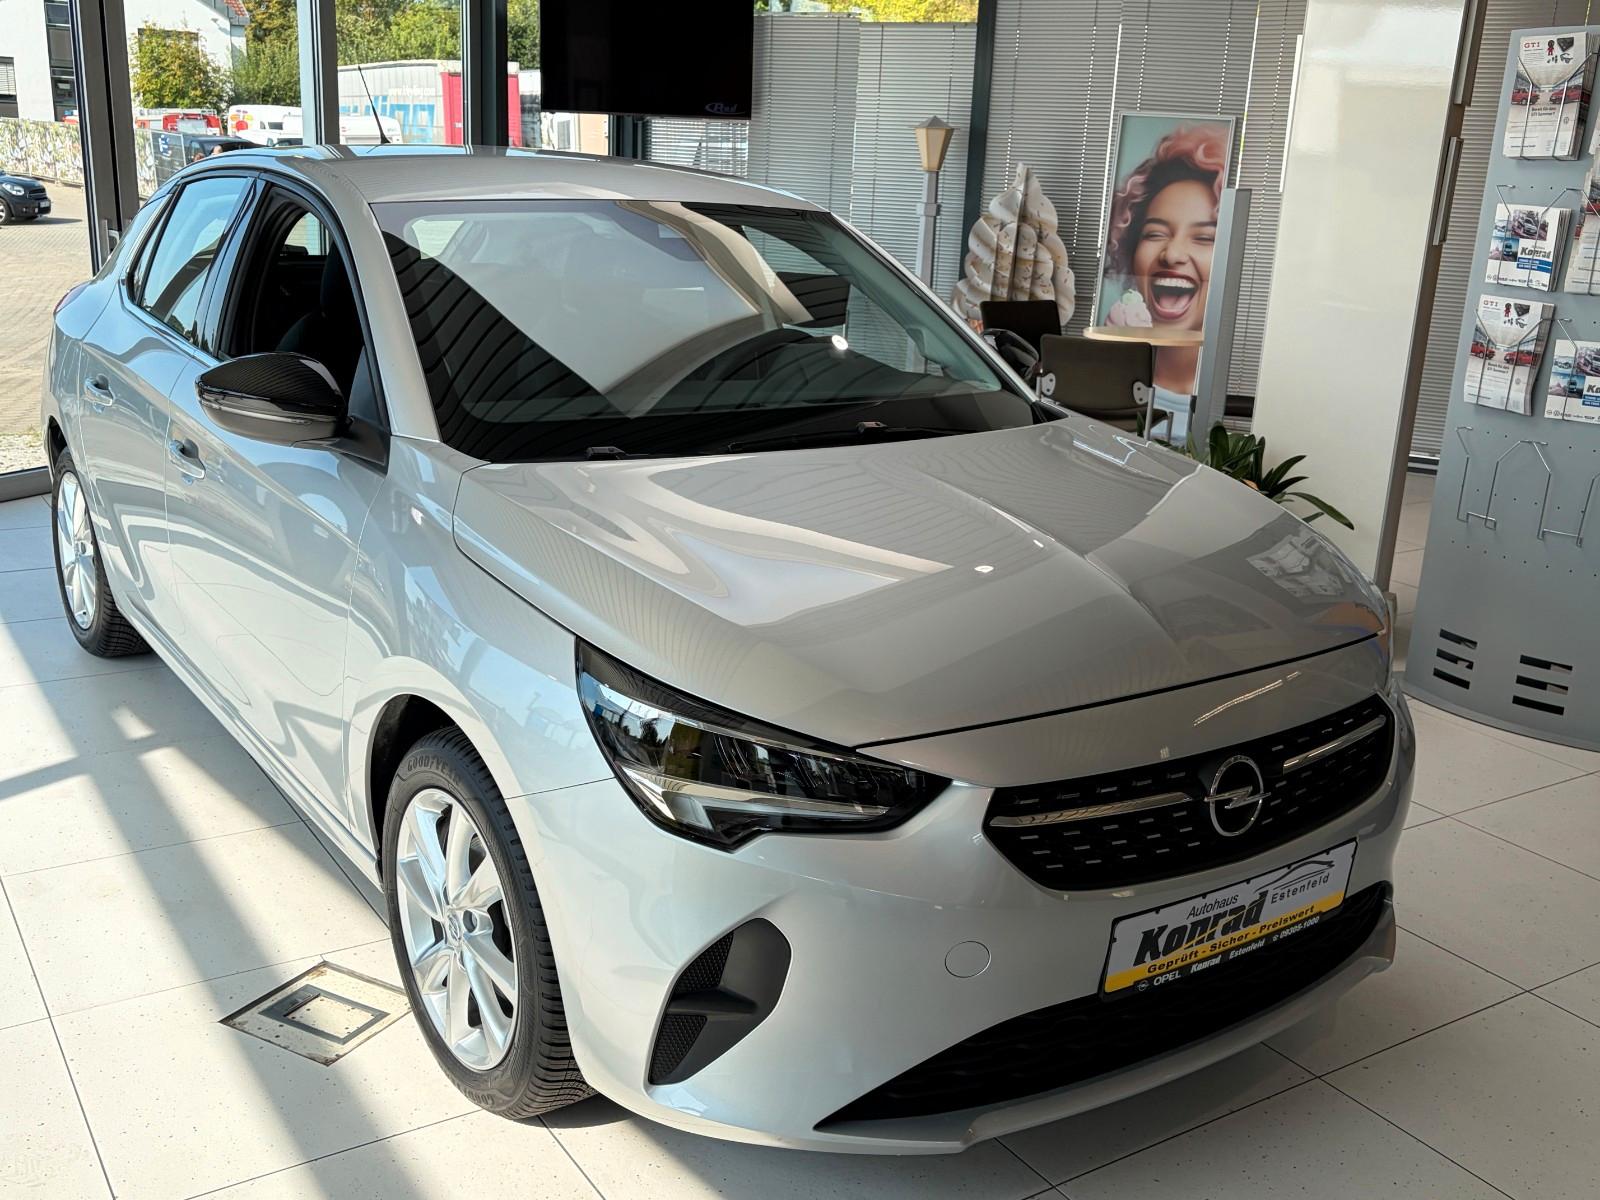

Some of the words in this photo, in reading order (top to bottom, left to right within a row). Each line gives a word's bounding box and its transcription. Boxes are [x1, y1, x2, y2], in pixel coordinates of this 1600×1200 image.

[1186, 894, 1239, 919] Autohaus
[1271, 873, 1330, 904] Estenfeld
[1133, 890, 1268, 967] Konrad
[1147, 950, 1199, 973] Geprüft
[1209, 931, 1250, 952] Sicher
[1259, 905, 1315, 934] Preiswert
[1153, 970, 1181, 986] OPEL
[1190, 954, 1222, 974] Konrad
[1229, 939, 1265, 960] Estenfeld
